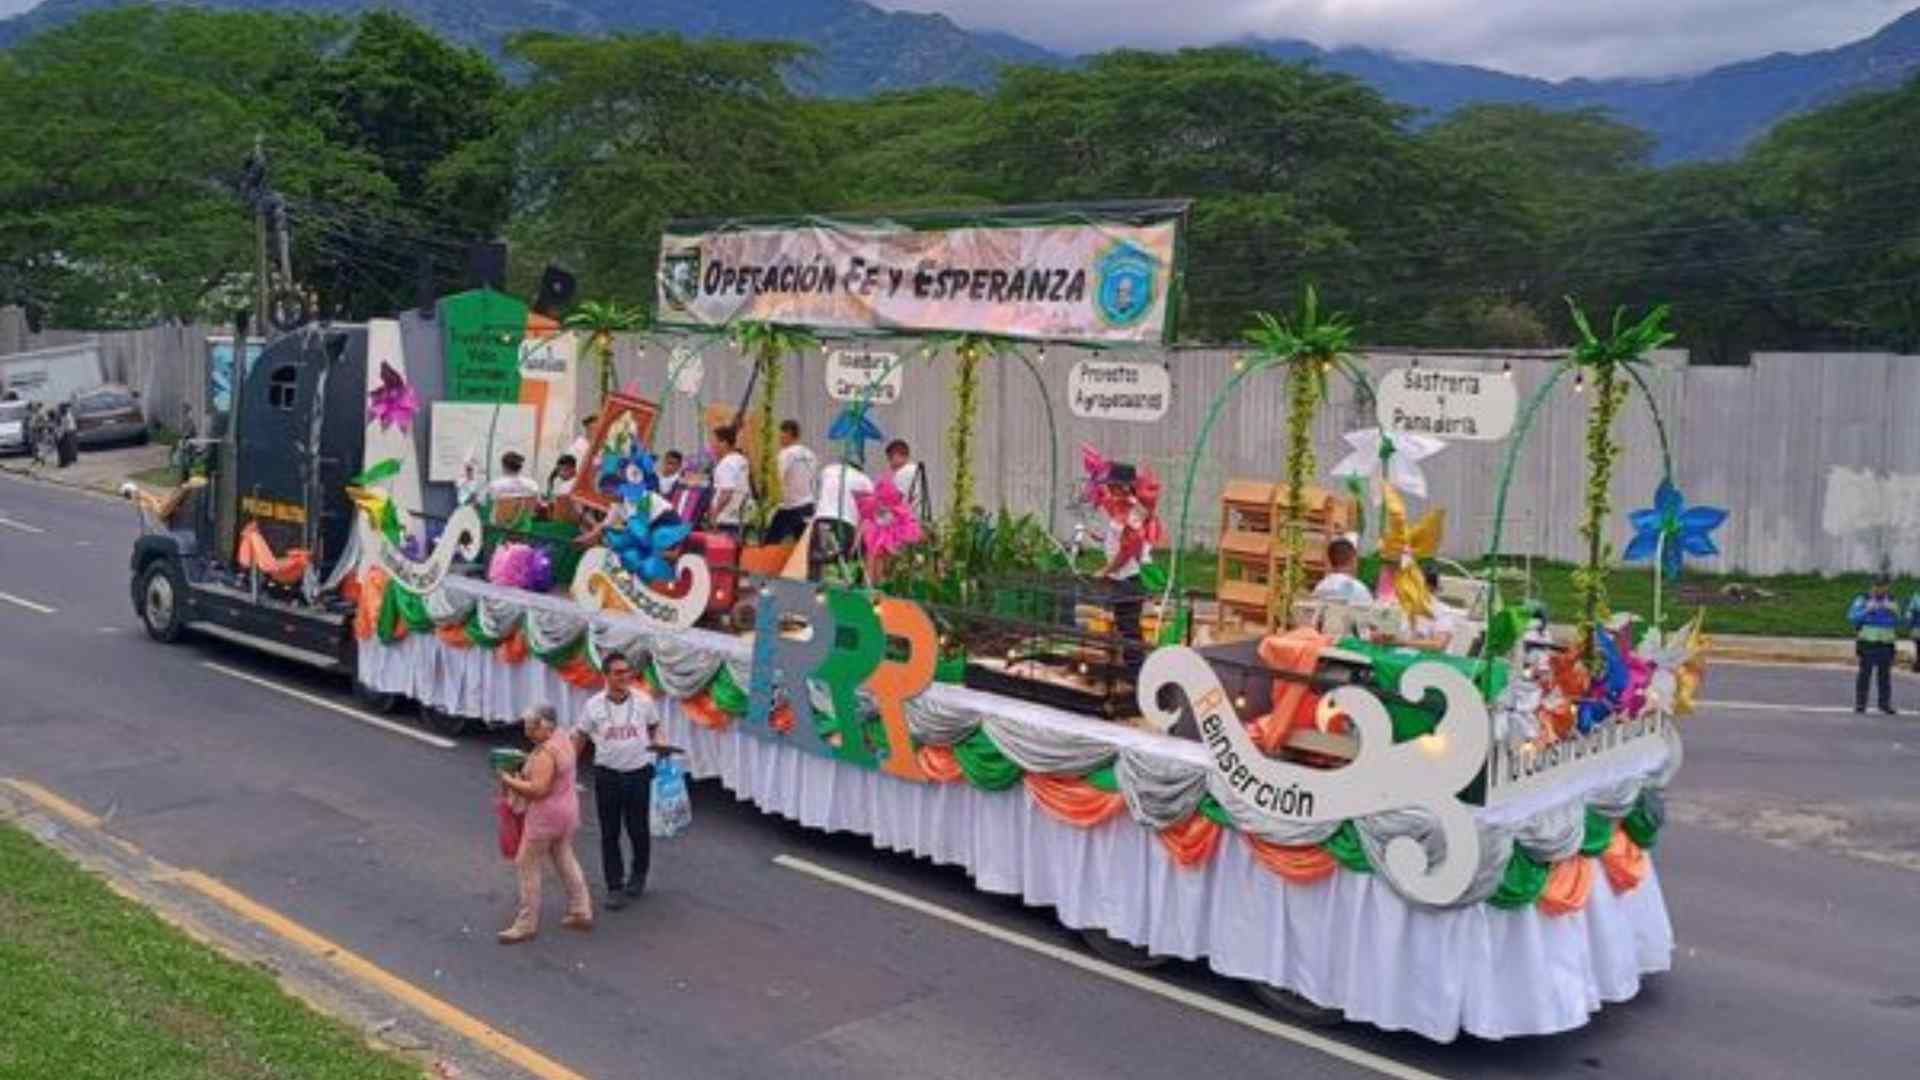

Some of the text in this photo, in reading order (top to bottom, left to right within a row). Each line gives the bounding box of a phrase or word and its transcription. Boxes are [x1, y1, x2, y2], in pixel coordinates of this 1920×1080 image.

[913, 258, 1087, 304] ESPERANZA
[1080, 362, 1139, 384] Proyectos
[1074, 387, 1163, 414] Agropecuarios
[1192, 686, 1315, 819] Reinserción
